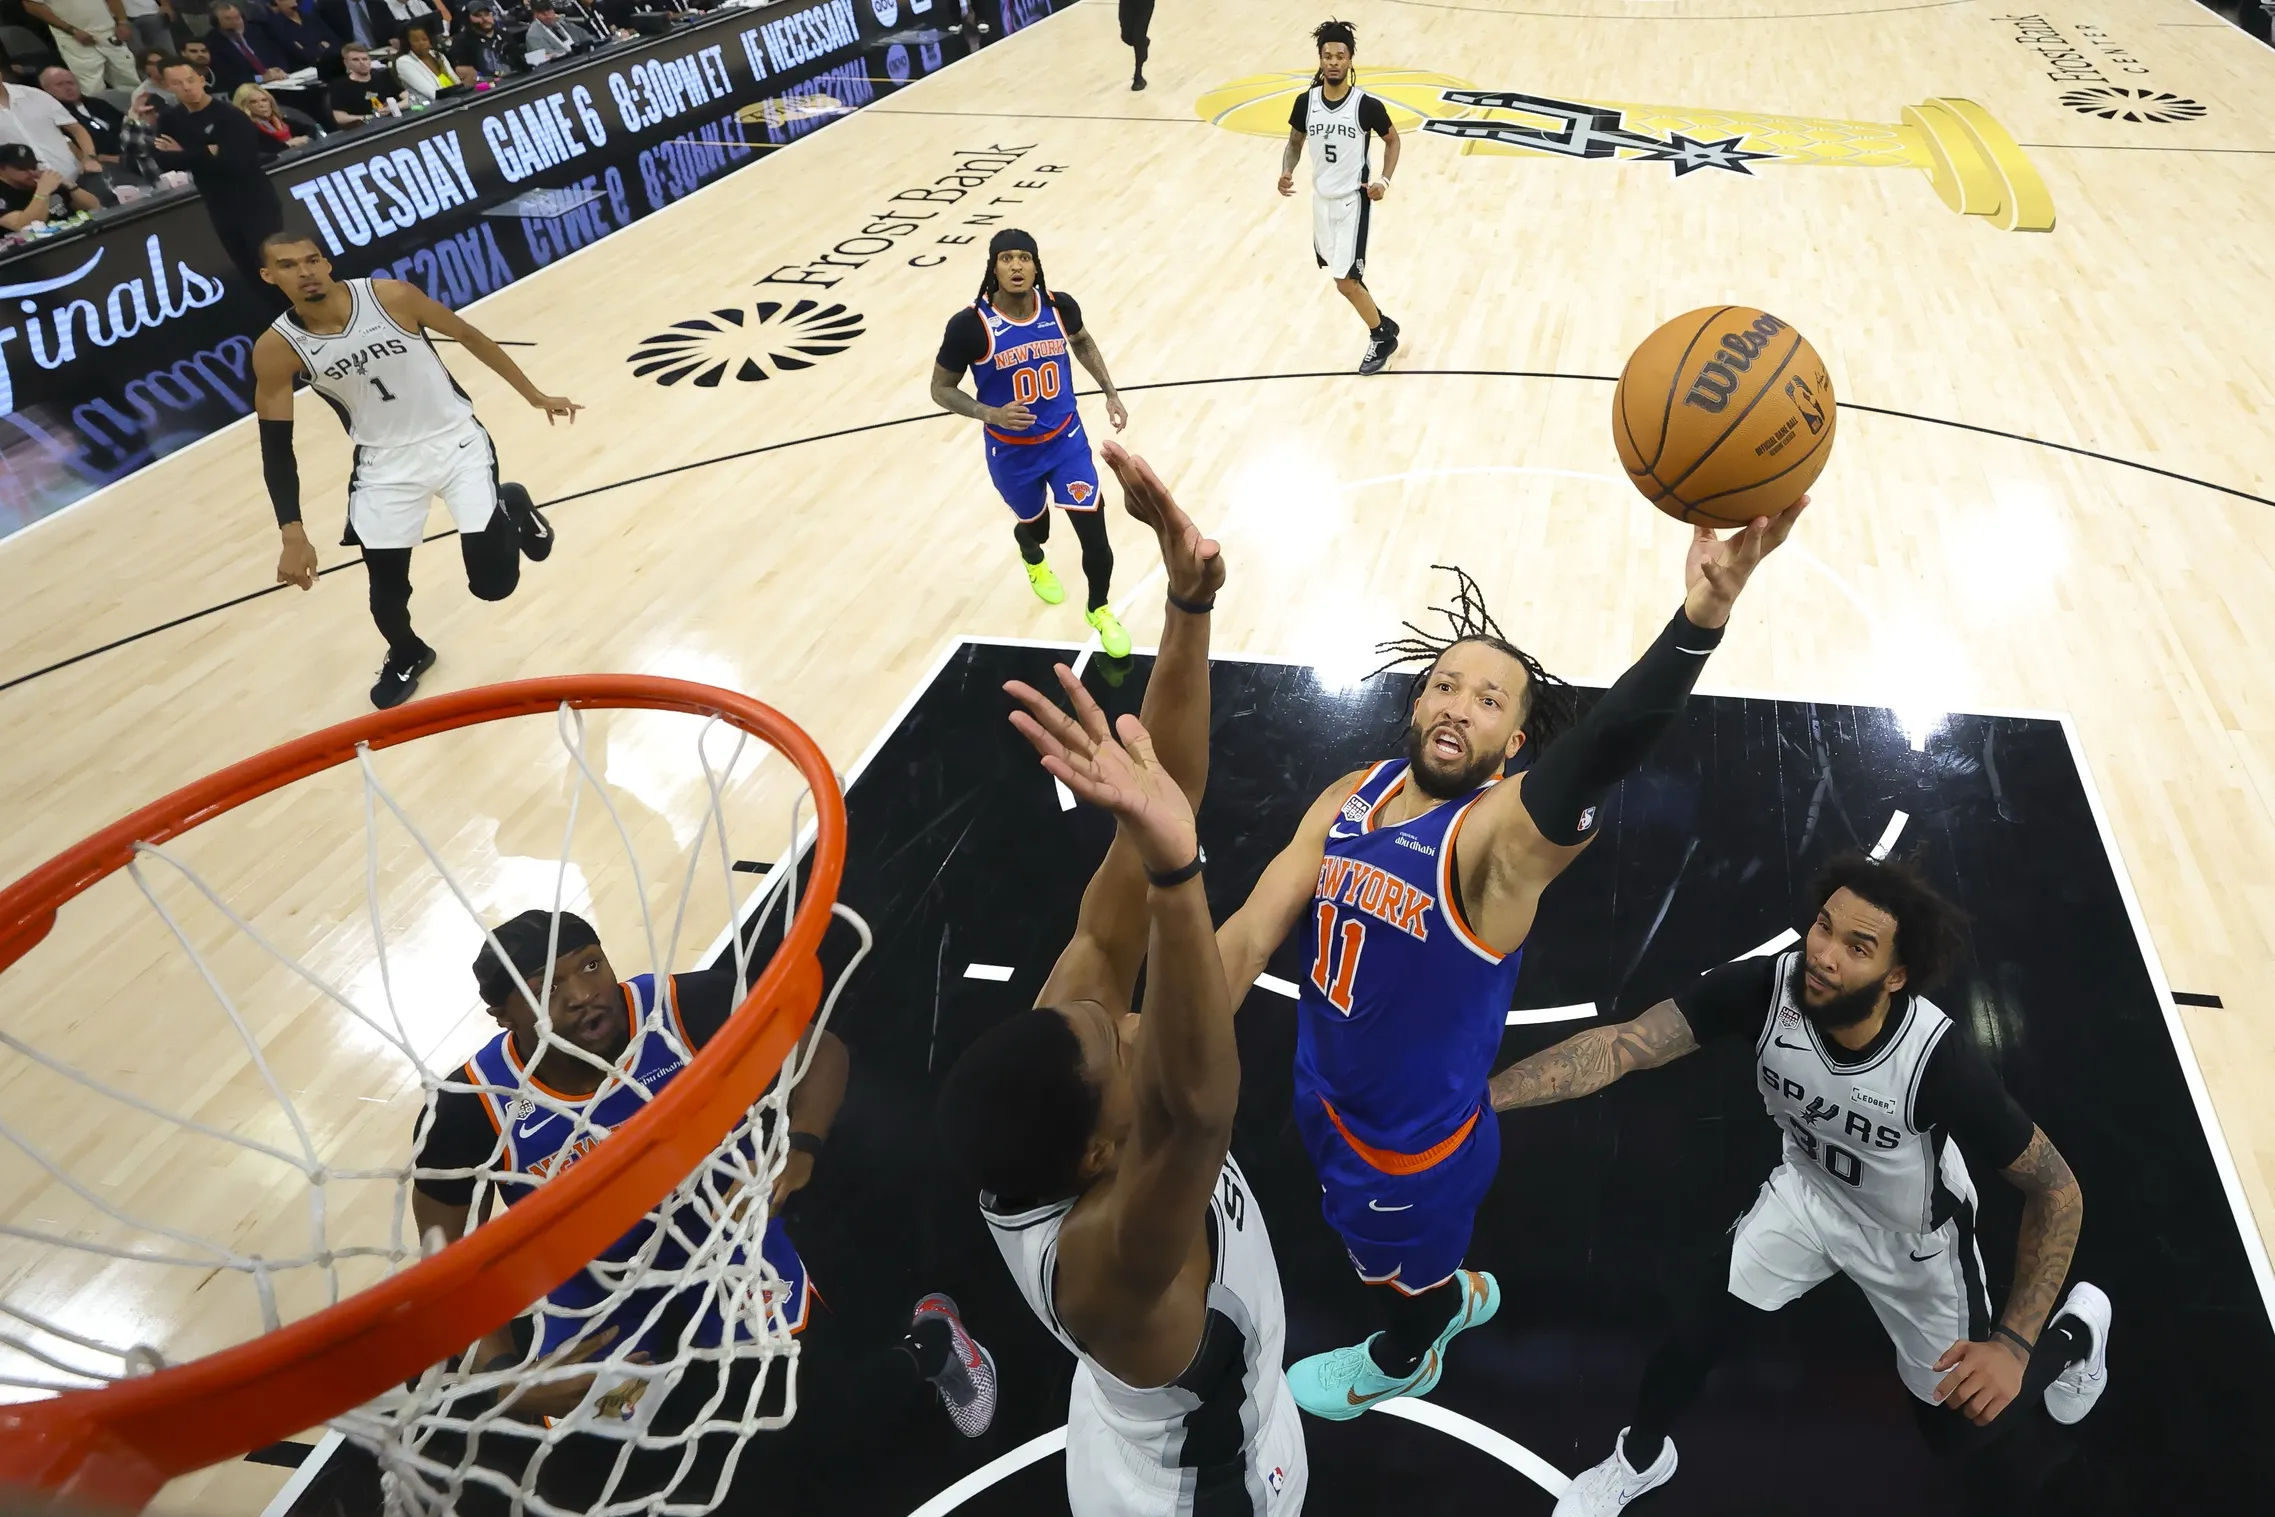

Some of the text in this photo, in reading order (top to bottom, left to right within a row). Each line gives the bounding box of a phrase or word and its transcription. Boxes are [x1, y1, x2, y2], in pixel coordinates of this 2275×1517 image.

[2074, 24, 2150, 74] CENTER
[290, 0, 860, 257] TUESDAY GAME 6 8:30PM ET IF NECESSARY
[1309, 123, 1356, 139] SPURS
[1325, 144, 1337, 164] 5
[753, 143, 1038, 289] Frost Bank
[908, 164, 1070, 268] CENTER
[324, 339, 407, 380] SPURS
[994, 338, 1066, 370] NEW YORK
[1684, 313, 1789, 414] Wilson
[370, 378, 396, 402] 1
[1012, 360, 1060, 405] 00
[1394, 837, 1436, 857] abu dhabi
[1343, 860, 1435, 943] YORK
[1311, 900, 1366, 1017] 11
[1762, 1066, 1901, 1149] SPURS
[1856, 1092, 1890, 1110] LEDGER
[1789, 1116, 1864, 1188] 30
